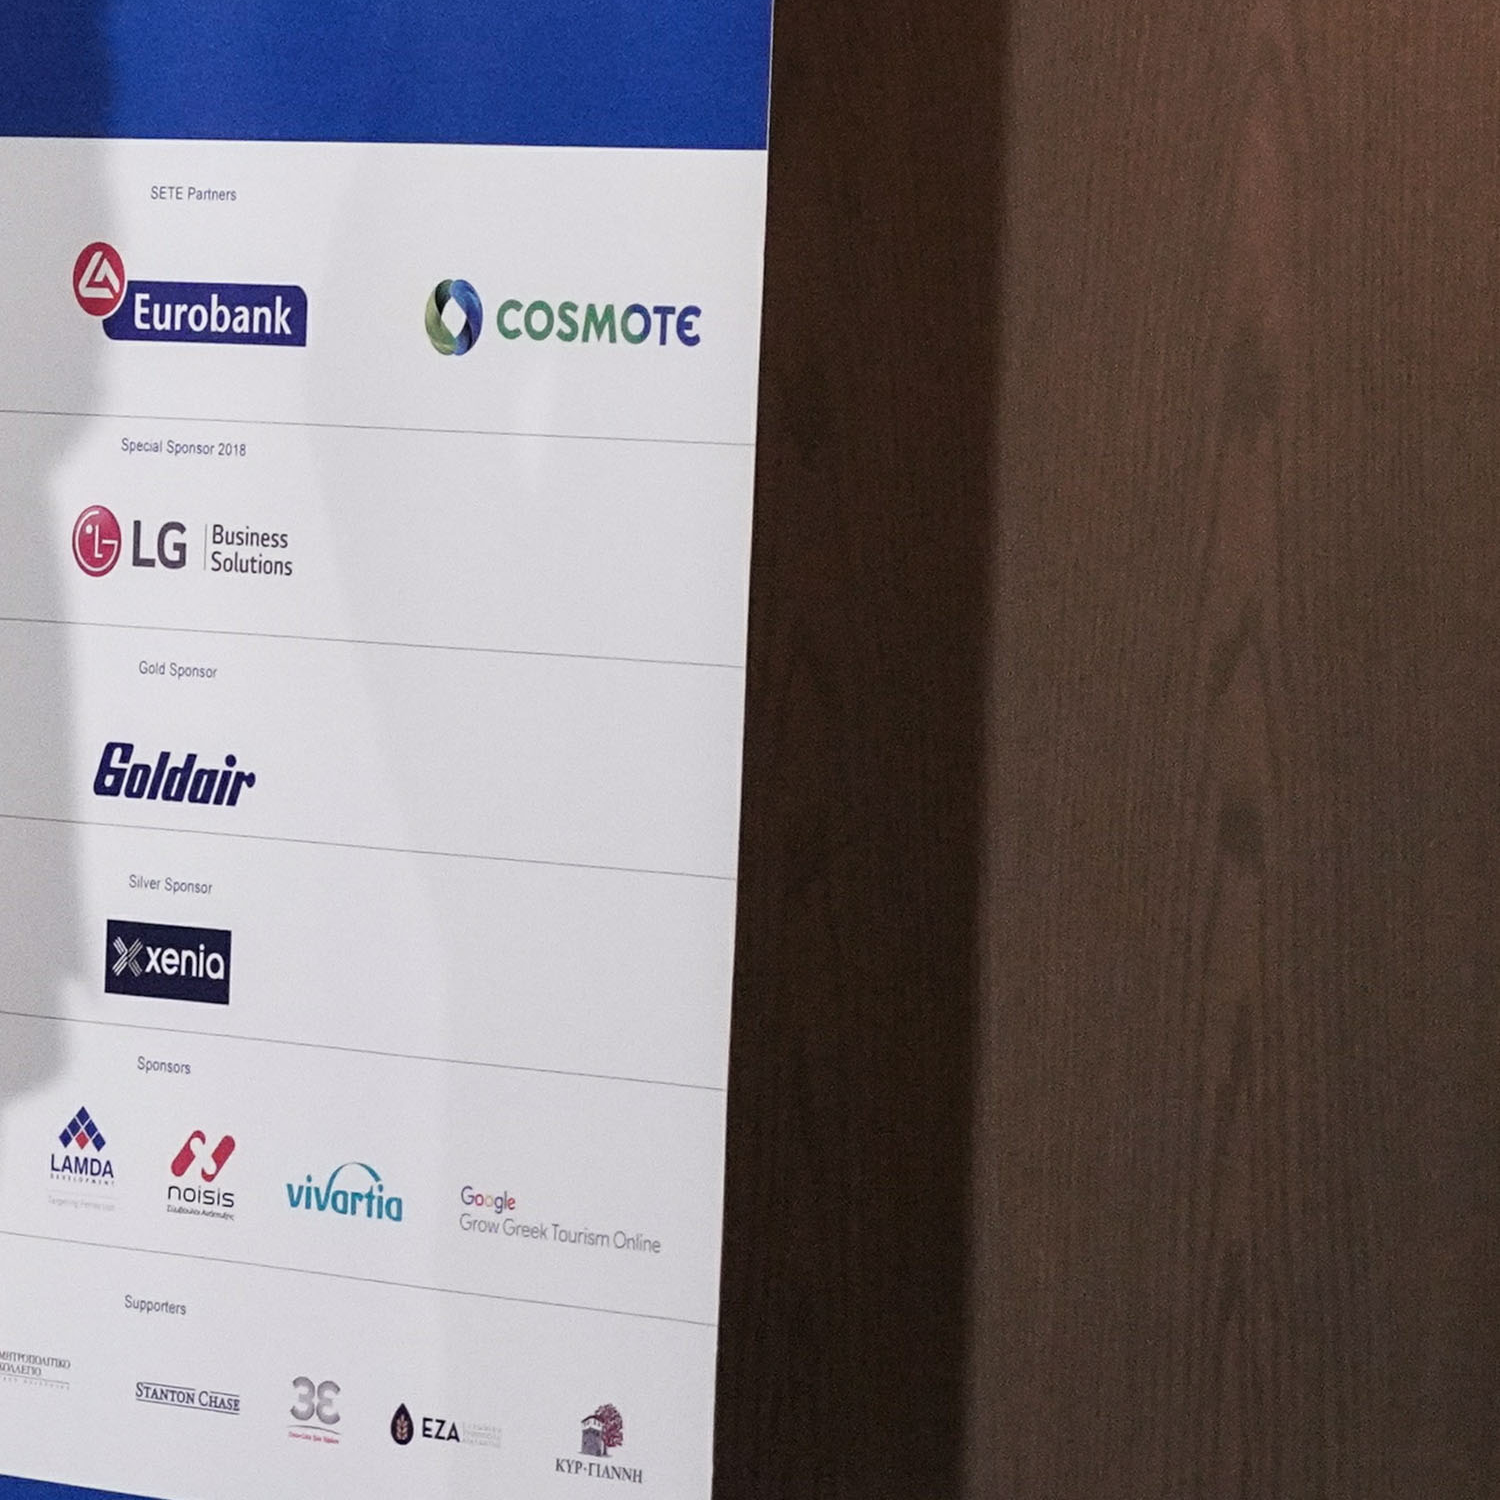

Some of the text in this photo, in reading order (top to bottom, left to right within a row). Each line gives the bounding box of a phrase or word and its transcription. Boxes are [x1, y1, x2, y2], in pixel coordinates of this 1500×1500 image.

[150, 186, 237, 201] SETE Partners
[134, 292, 292, 335] Eurobank
[496, 299, 702, 347] COSMOTE
[121, 438, 247, 457] Special Sponsor 2018
[132, 520, 187, 570] LG
[212, 524, 289, 549] Business
[211, 551, 293, 576] Solutions
[139, 660, 218, 679] Gold Sponsor
[93, 742, 256, 806] Goldair
[129, 874, 213, 894] Silver Sponsor
[145, 943, 225, 980] xenia
[137, 1056, 191, 1075] Sponsors
[51, 1153, 114, 1178] LAMDA
[167, 1185, 234, 1207] noisis
[286, 1162, 403, 1222] vivartia
[460, 1185, 516, 1214] Google
[459, 1213, 661, 1254] Grow Greek Tourism Online
[124, 1294, 186, 1315] Supporters
